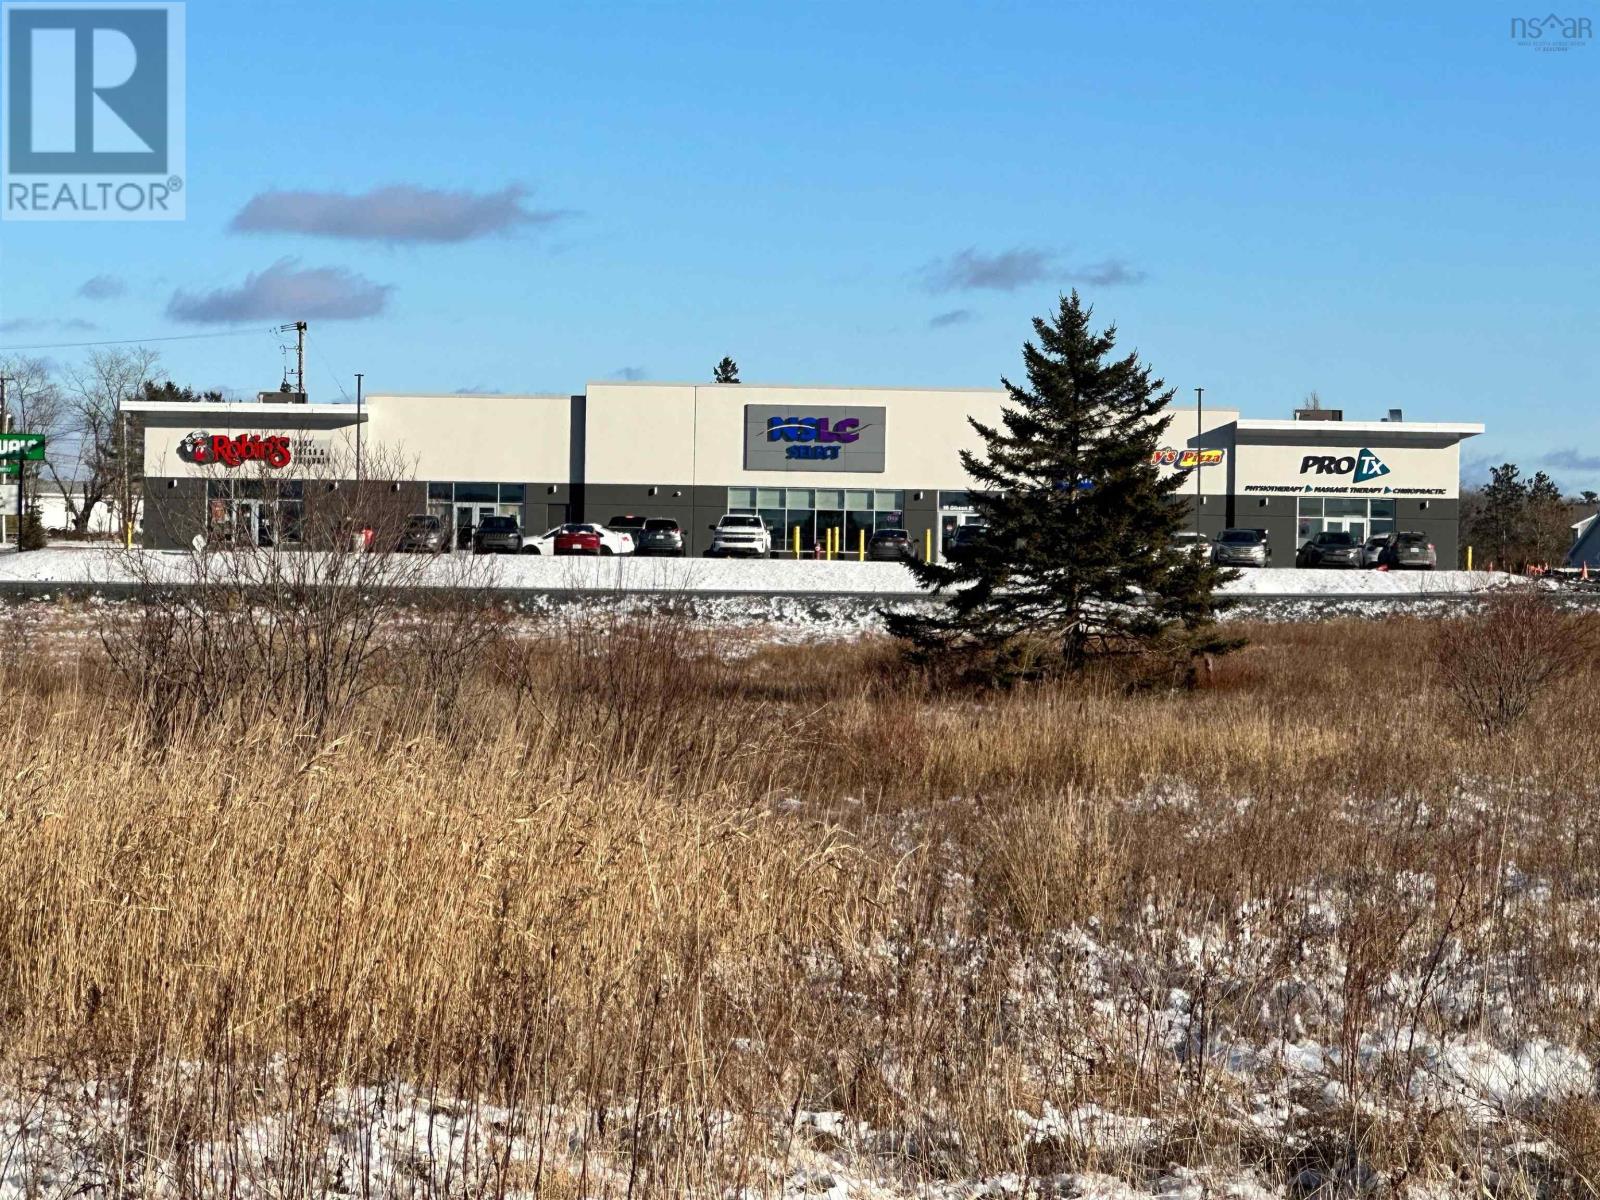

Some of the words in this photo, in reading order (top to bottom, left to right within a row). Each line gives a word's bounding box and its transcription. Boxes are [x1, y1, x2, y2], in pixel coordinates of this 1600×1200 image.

[766, 416, 860, 443] NSLC
[785, 445, 842, 460] SELECT
[1299, 455, 1356, 475] PRO
